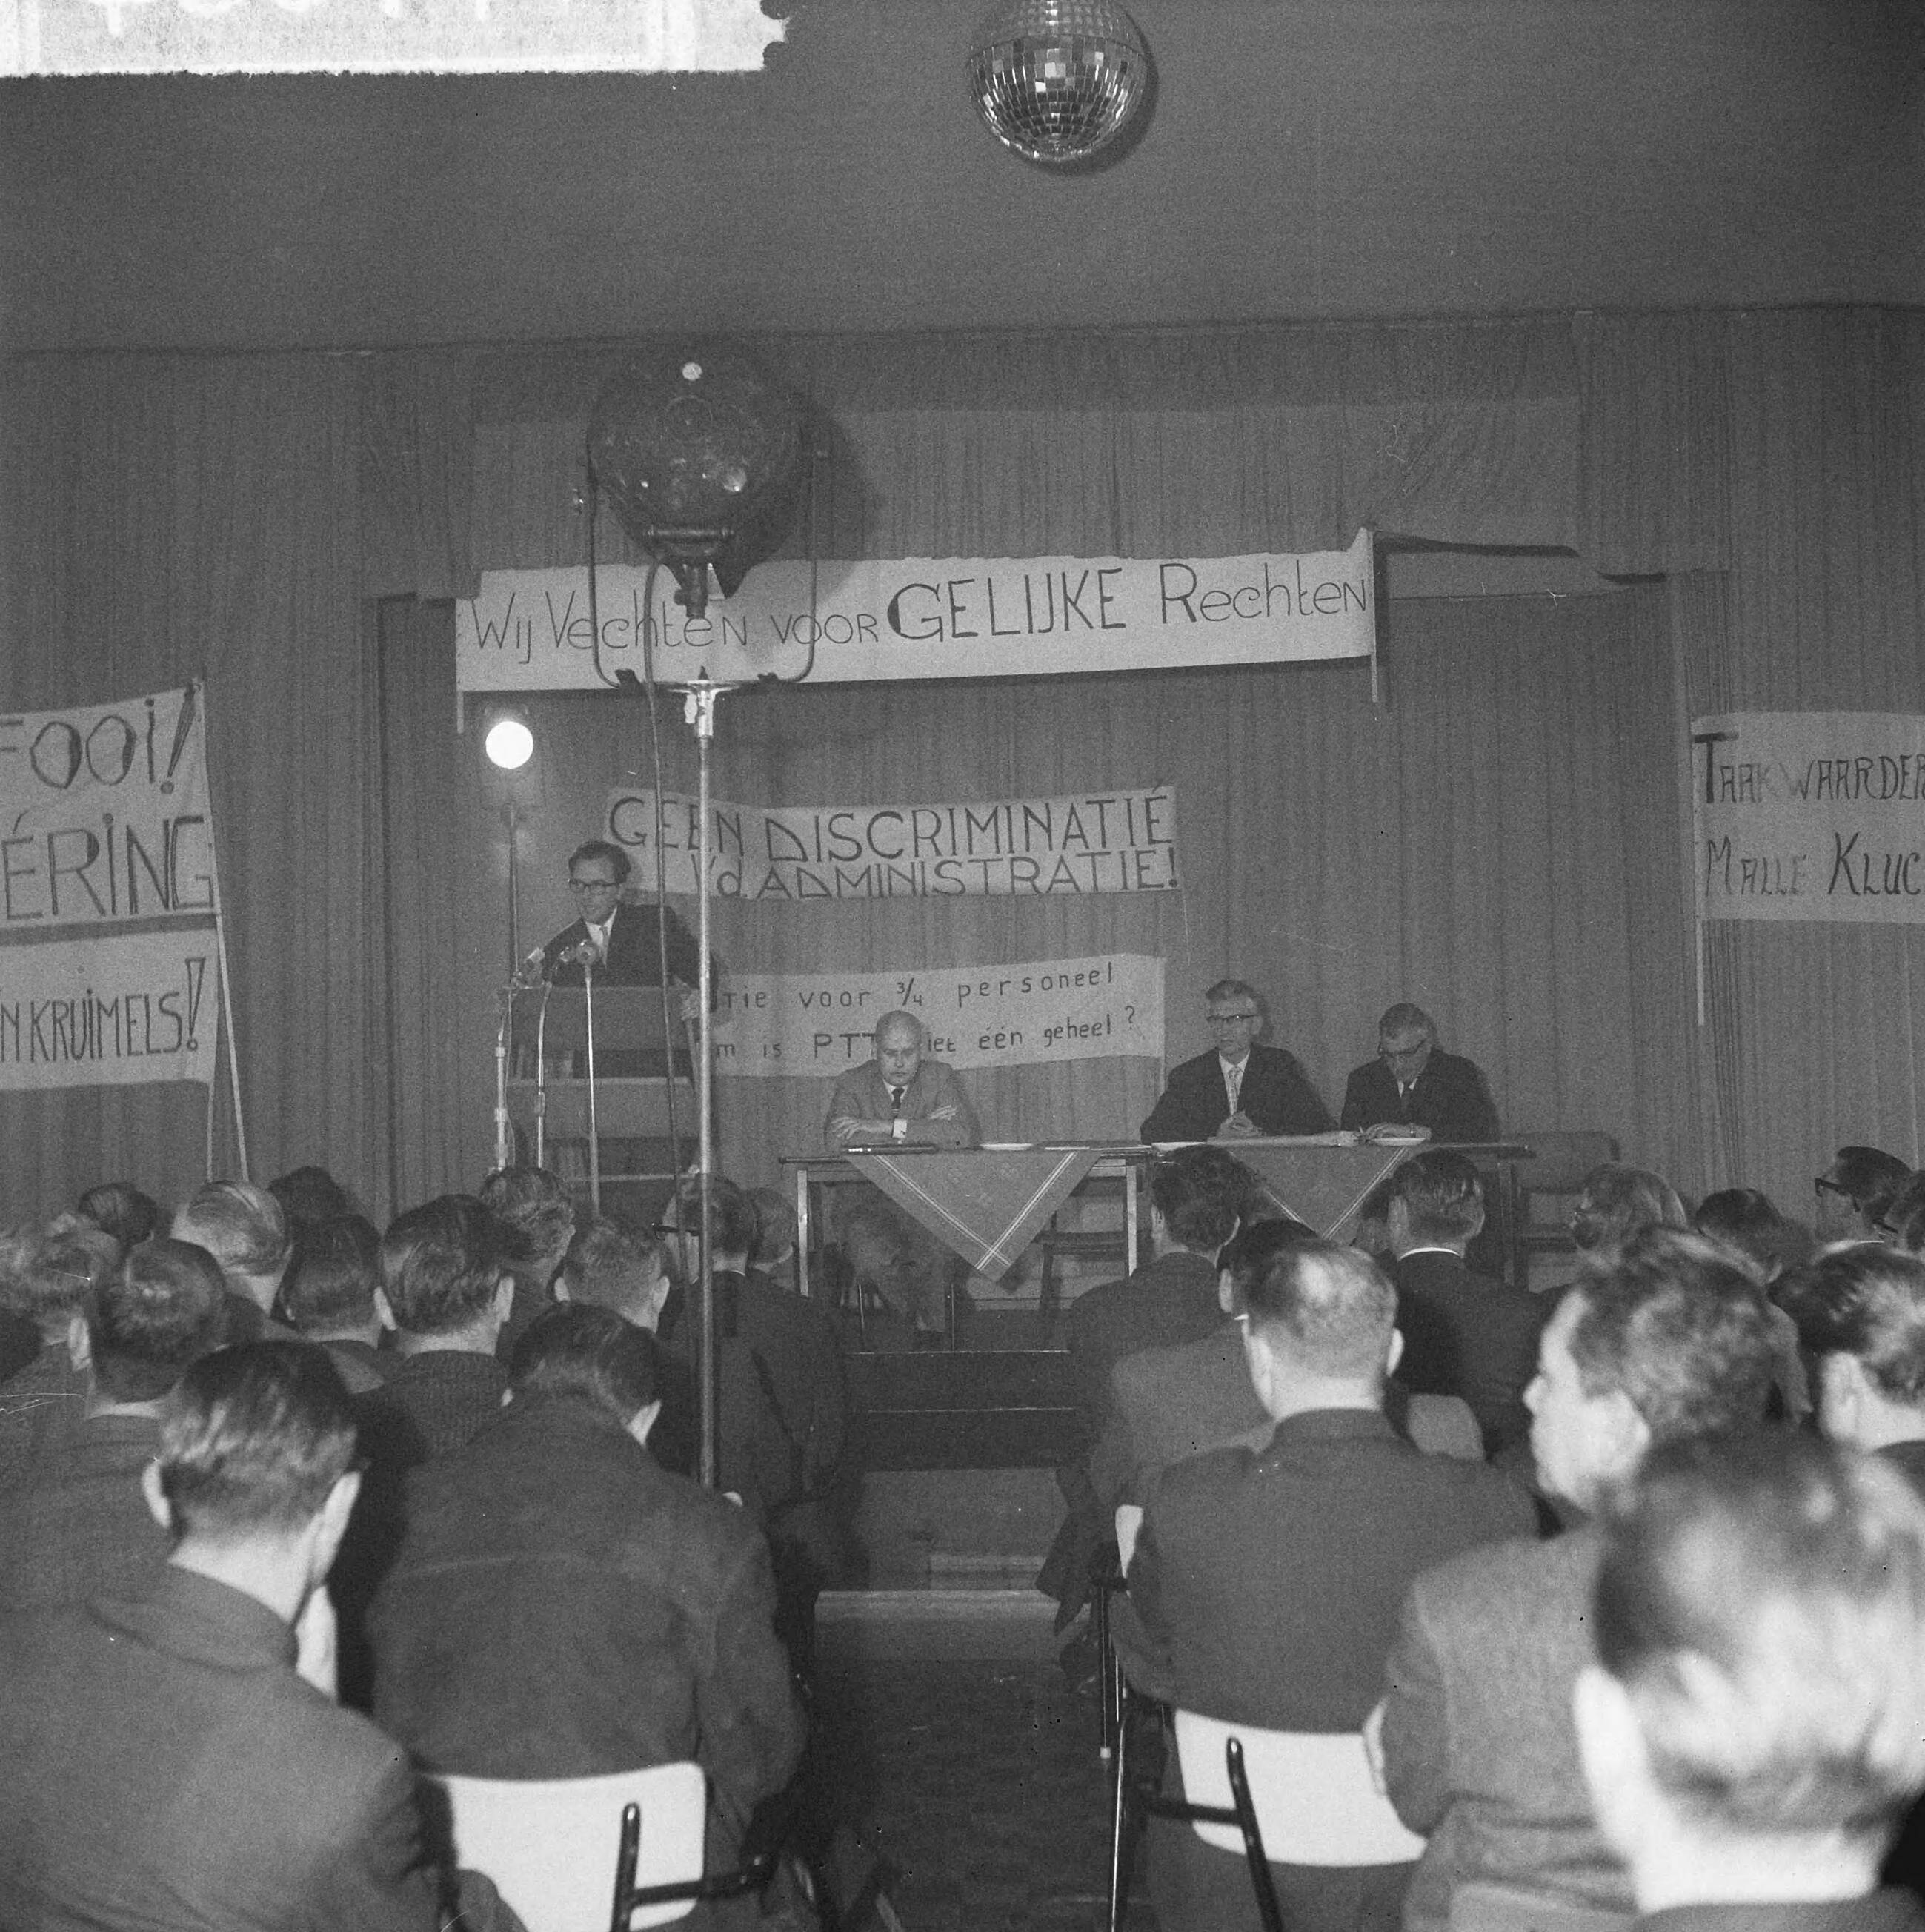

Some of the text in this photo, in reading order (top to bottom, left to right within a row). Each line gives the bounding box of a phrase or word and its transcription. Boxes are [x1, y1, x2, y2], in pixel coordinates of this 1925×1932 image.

[471, 591, 531, 665] Wij
[888, 567, 1127, 642] GELIJKE
[609, 794, 1172, 863] GEEN DISCRIMINATIE
[756, 846, 1178, 898] ADMINISTRATIE!
[798, 990, 871, 1009] voor
[957, 961, 1112, 1008] personeel
[927, 1032, 957, 1052] iet
